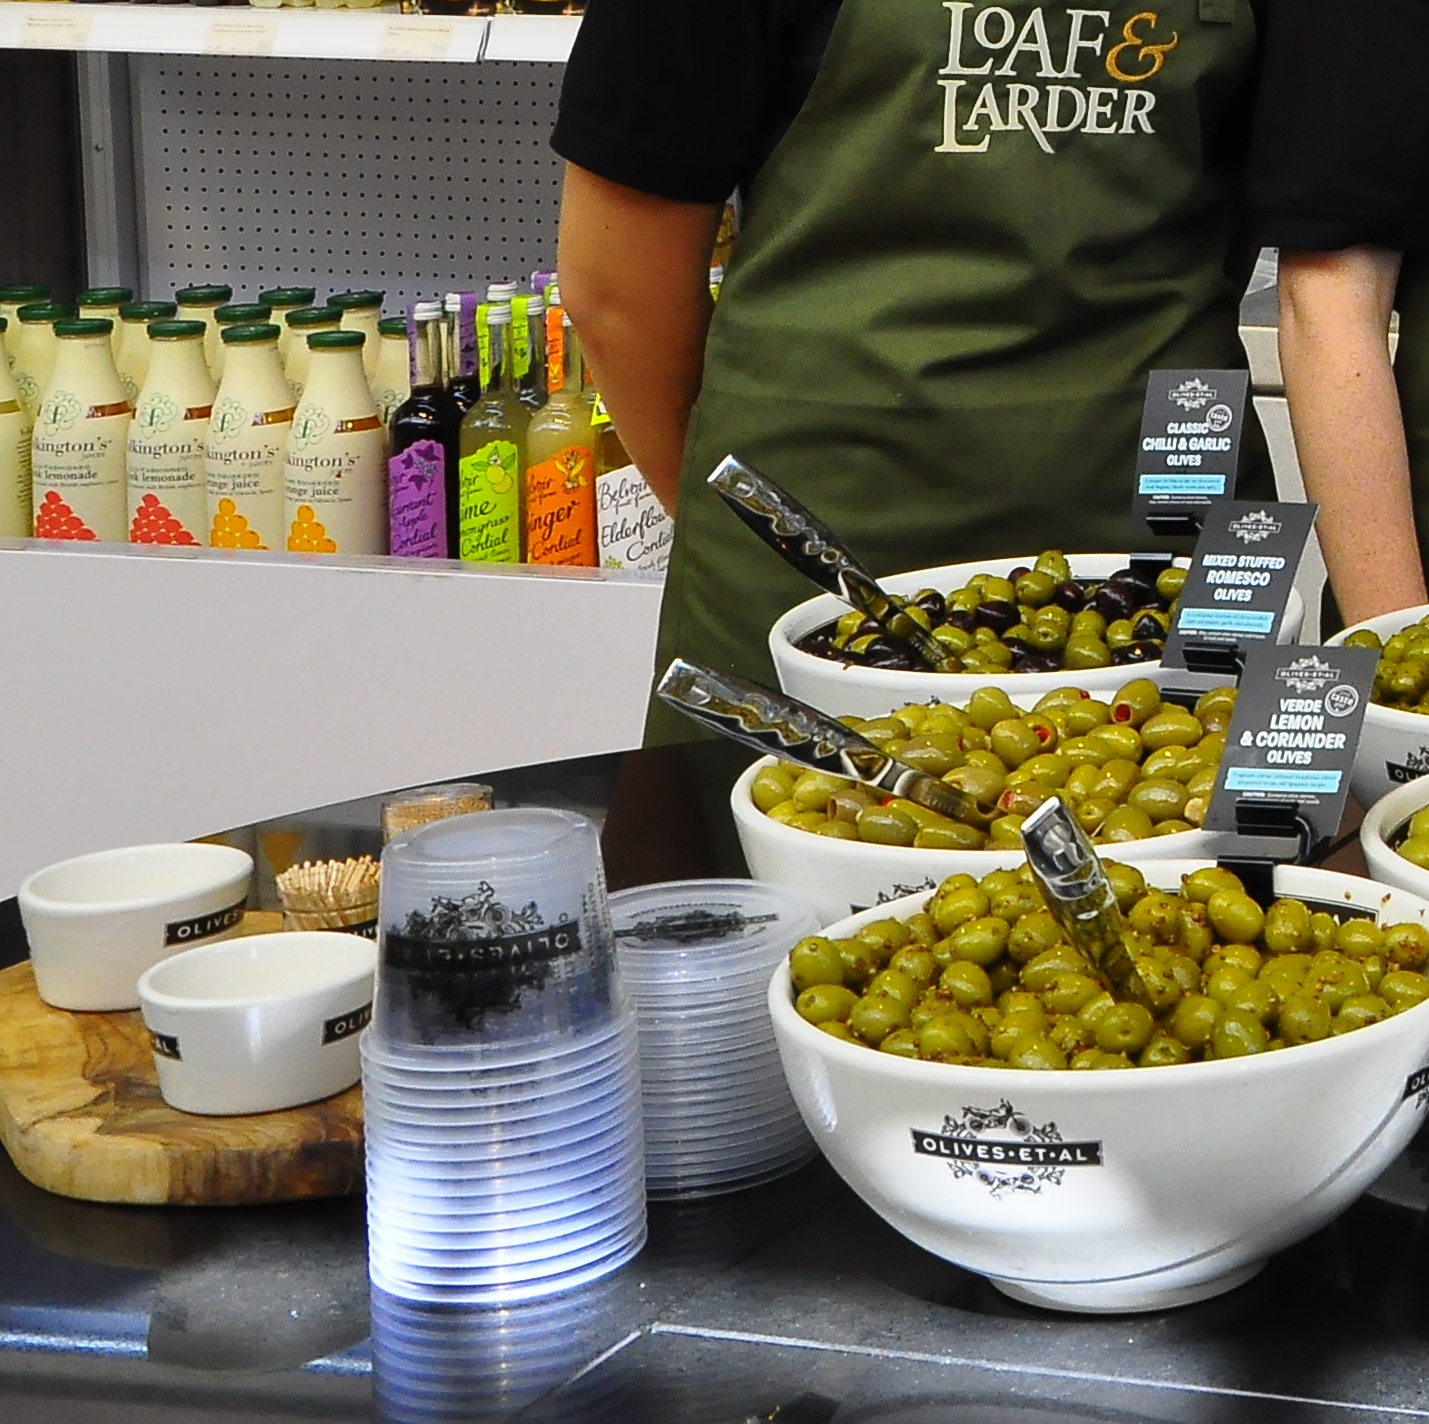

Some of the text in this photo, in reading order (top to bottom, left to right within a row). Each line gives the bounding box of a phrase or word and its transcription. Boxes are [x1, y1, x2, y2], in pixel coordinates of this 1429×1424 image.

[938, 1, 1110, 78] LOAF
[934, 79, 1156, 154] LARDER
[1167, 422, 1210, 434] CLASSIC
[1143, 437, 1231, 451] CHILLI & GARLIC
[1167, 454, 1202, 466] OLIVES
[532, 530, 581, 559] Cordial
[1202, 554, 1285, 569] MIXED STUFFED
[1206, 570, 1270, 586] ROMESCO
[1214, 588, 1252, 601] OLIVES
[1280, 698, 1322, 713] VERDE
[1270, 714, 1324, 730] LEMON
[1240, 730, 1346, 749] & CORIANDER
[1267, 750, 1312, 764] OLIVES
